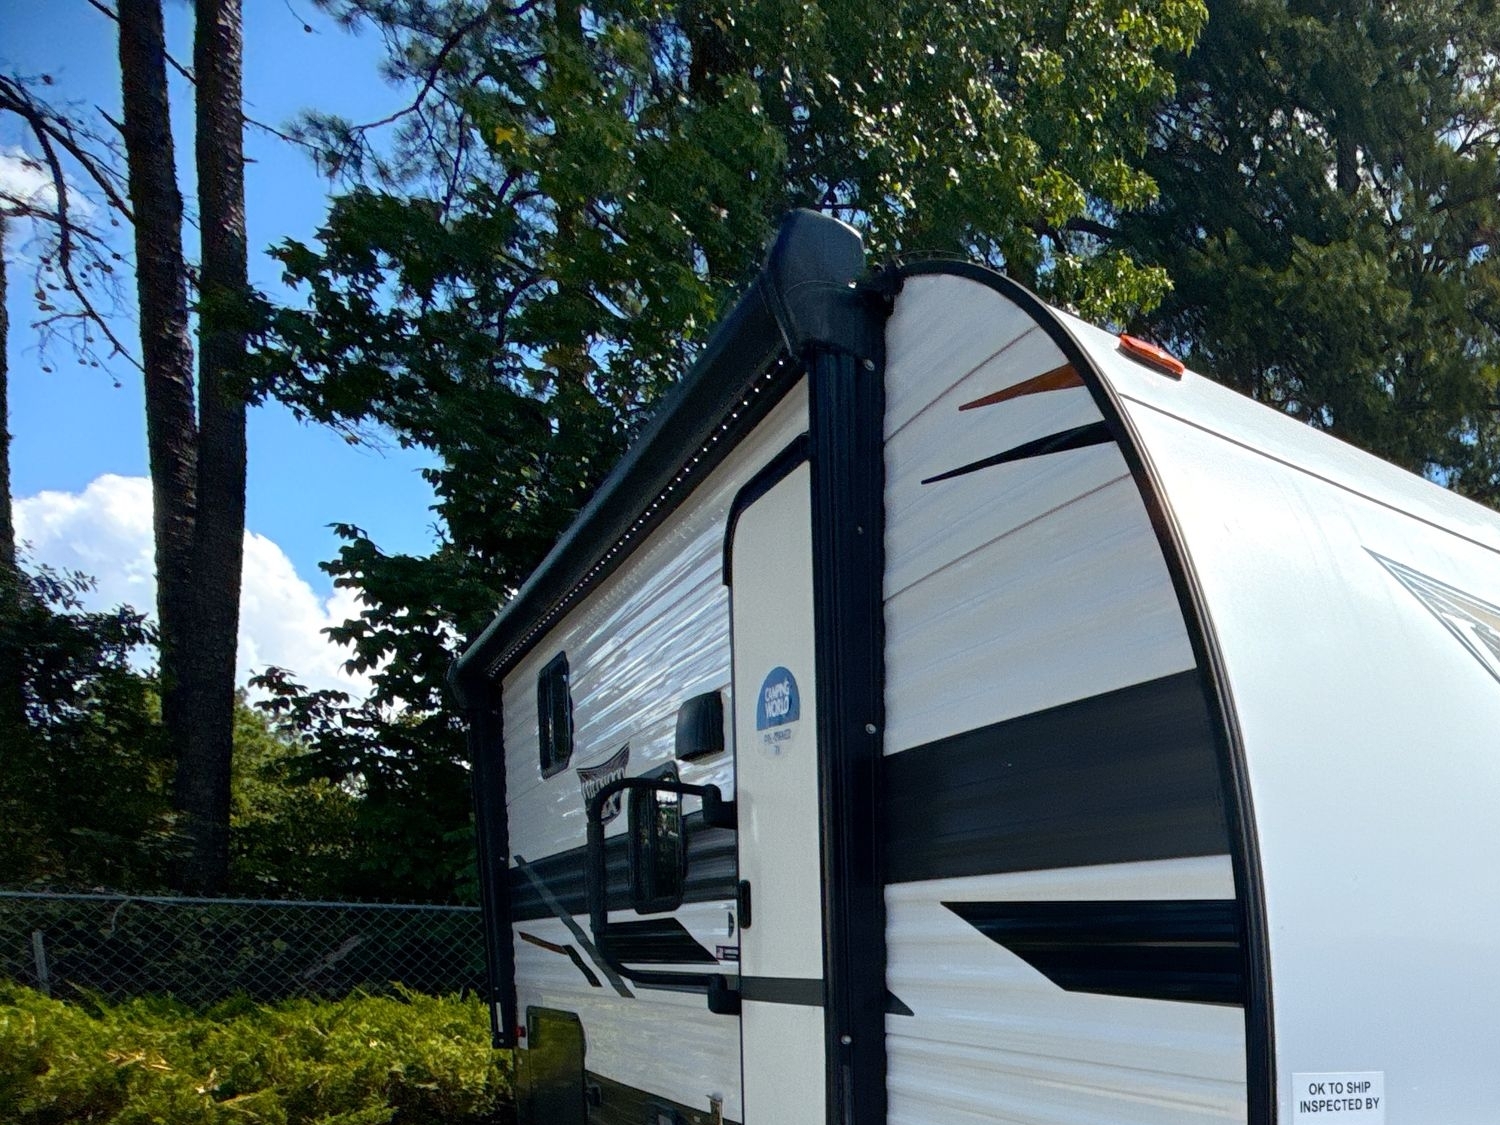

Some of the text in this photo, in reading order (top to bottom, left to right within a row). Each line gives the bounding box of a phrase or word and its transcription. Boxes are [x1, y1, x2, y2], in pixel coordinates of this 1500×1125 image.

[764, 679, 790, 702] CAMPING
[765, 697, 790, 718] WORLD
[1308, 1081, 1371, 1095] OK TO SHIP
[1300, 1097, 1380, 1113] INSPECTED BY
